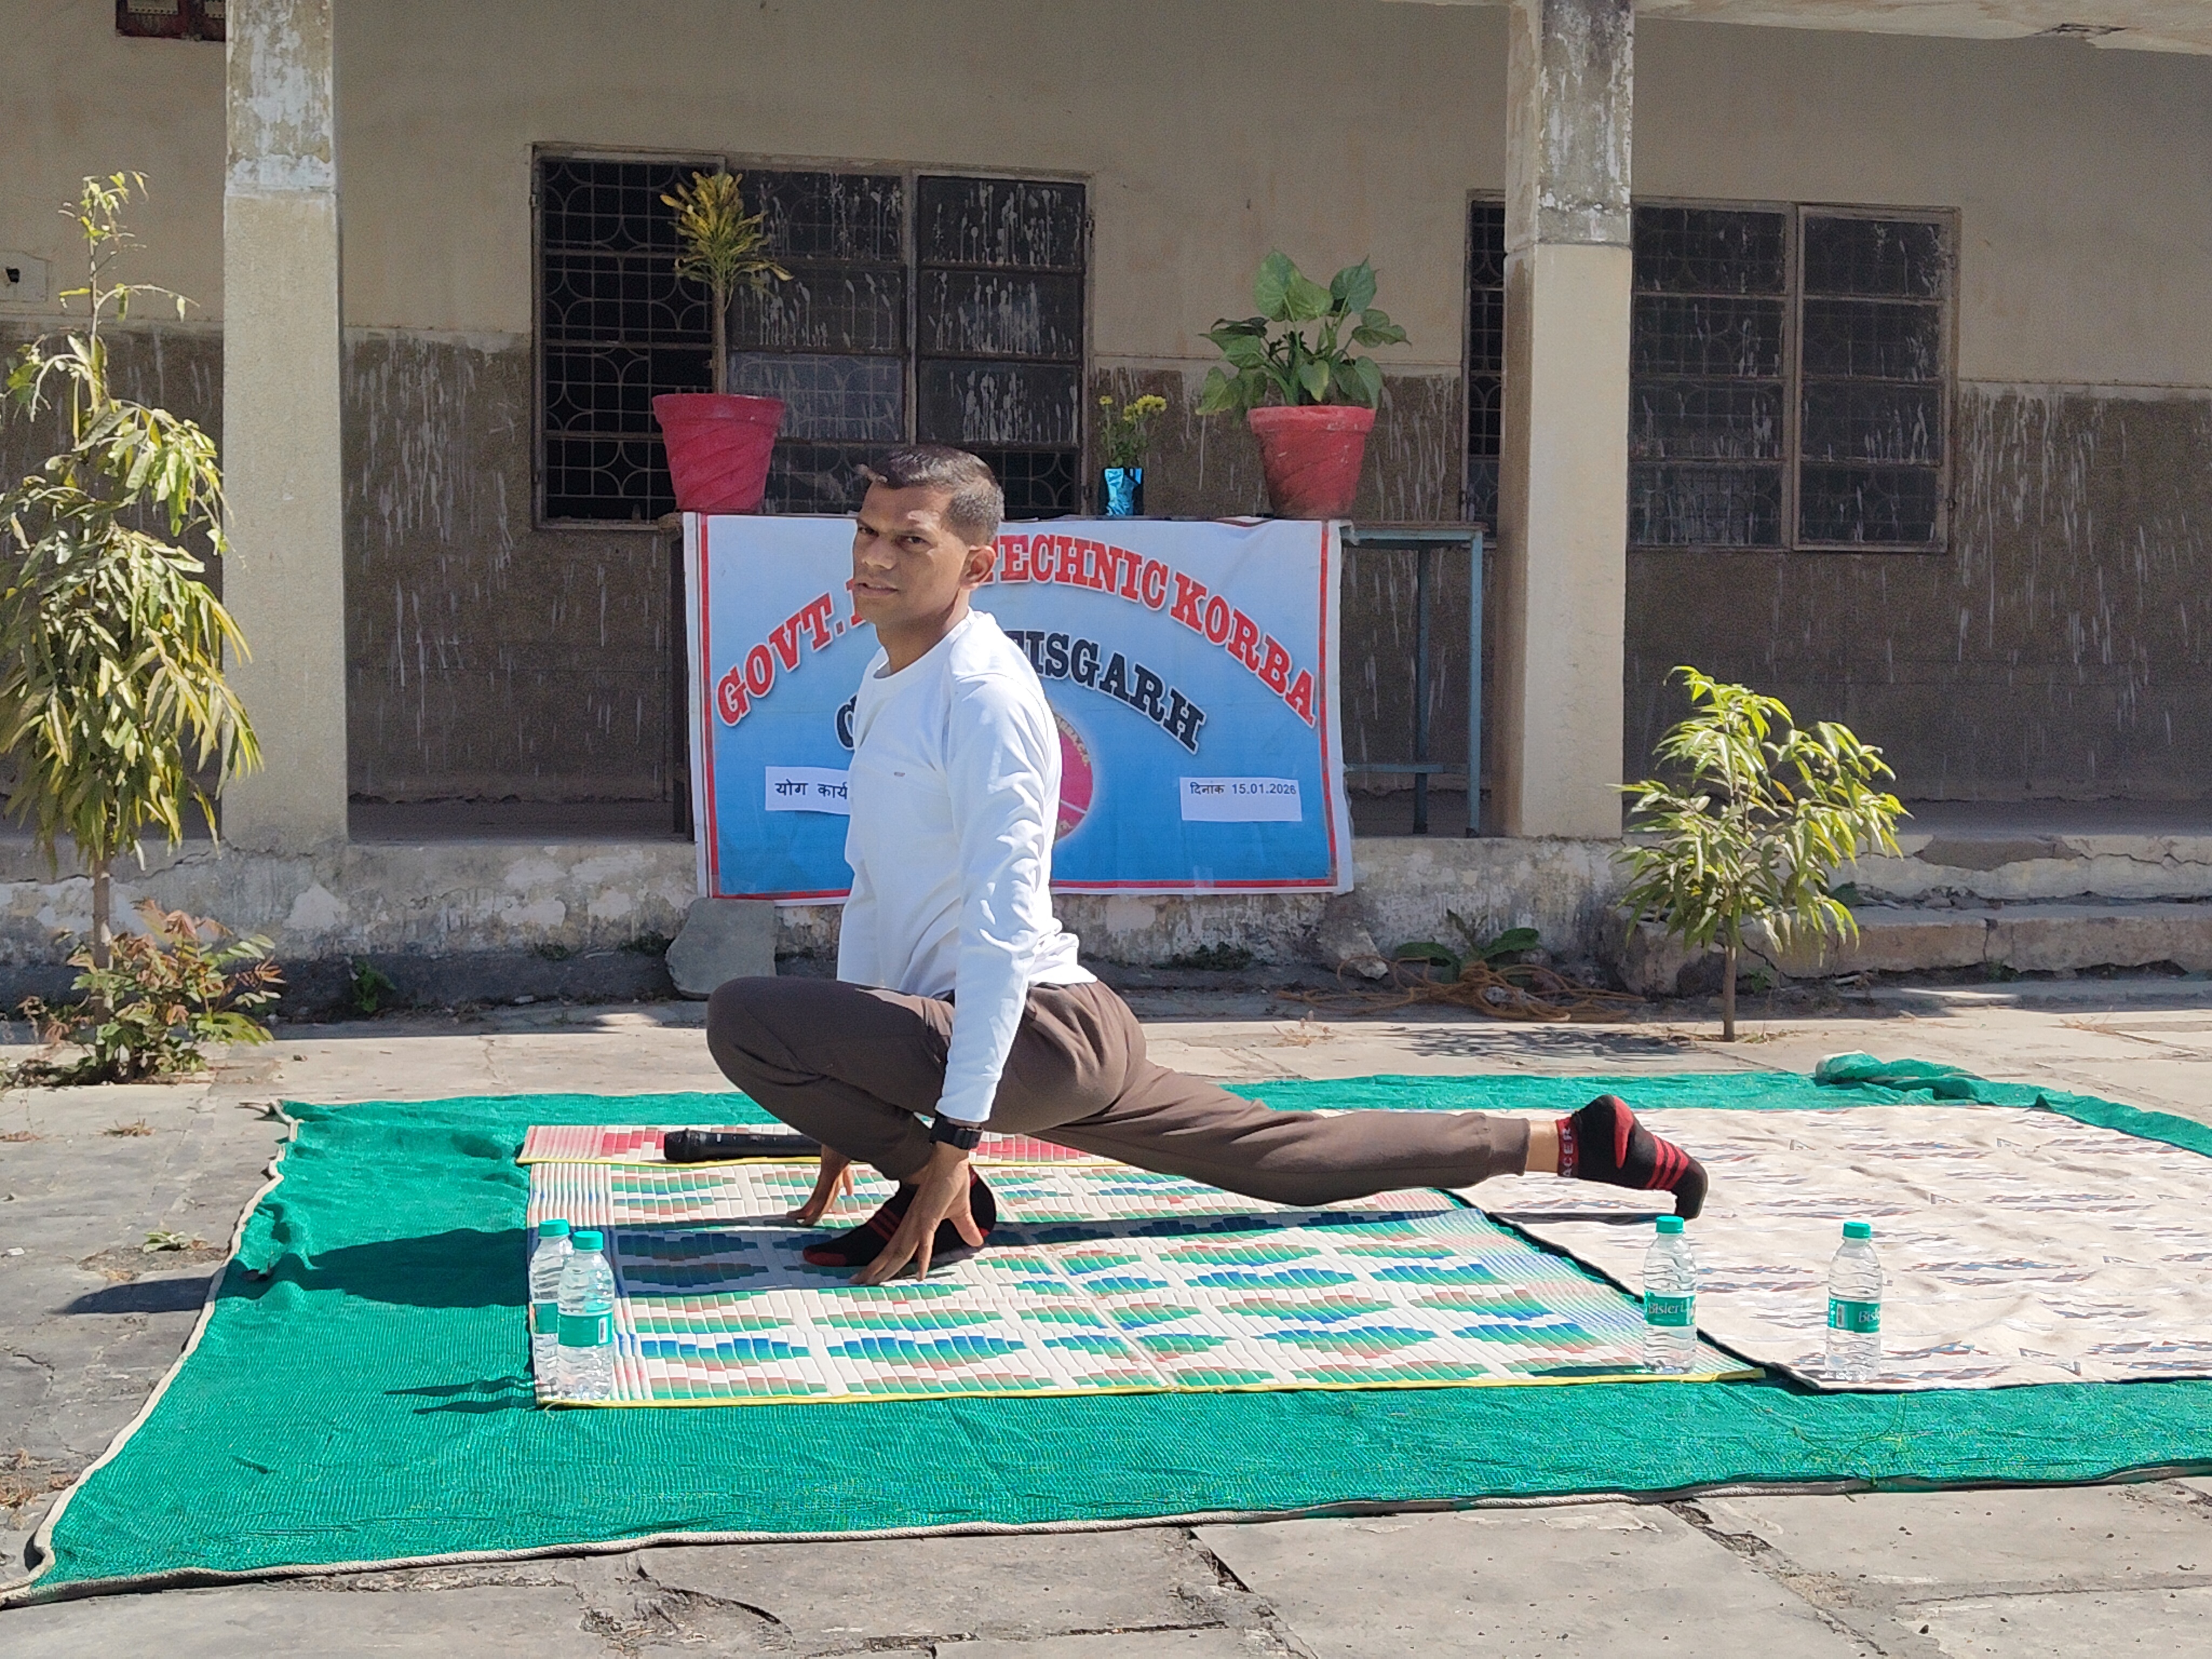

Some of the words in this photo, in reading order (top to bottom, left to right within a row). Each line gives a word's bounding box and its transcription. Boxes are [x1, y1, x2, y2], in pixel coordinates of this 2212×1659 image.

[716, 591, 846, 725] GOVT.
[1170, 571, 1316, 728] KORBA
[775, 779, 808, 795] योग
[1232, 784, 1297, 794] 15.01.2026
